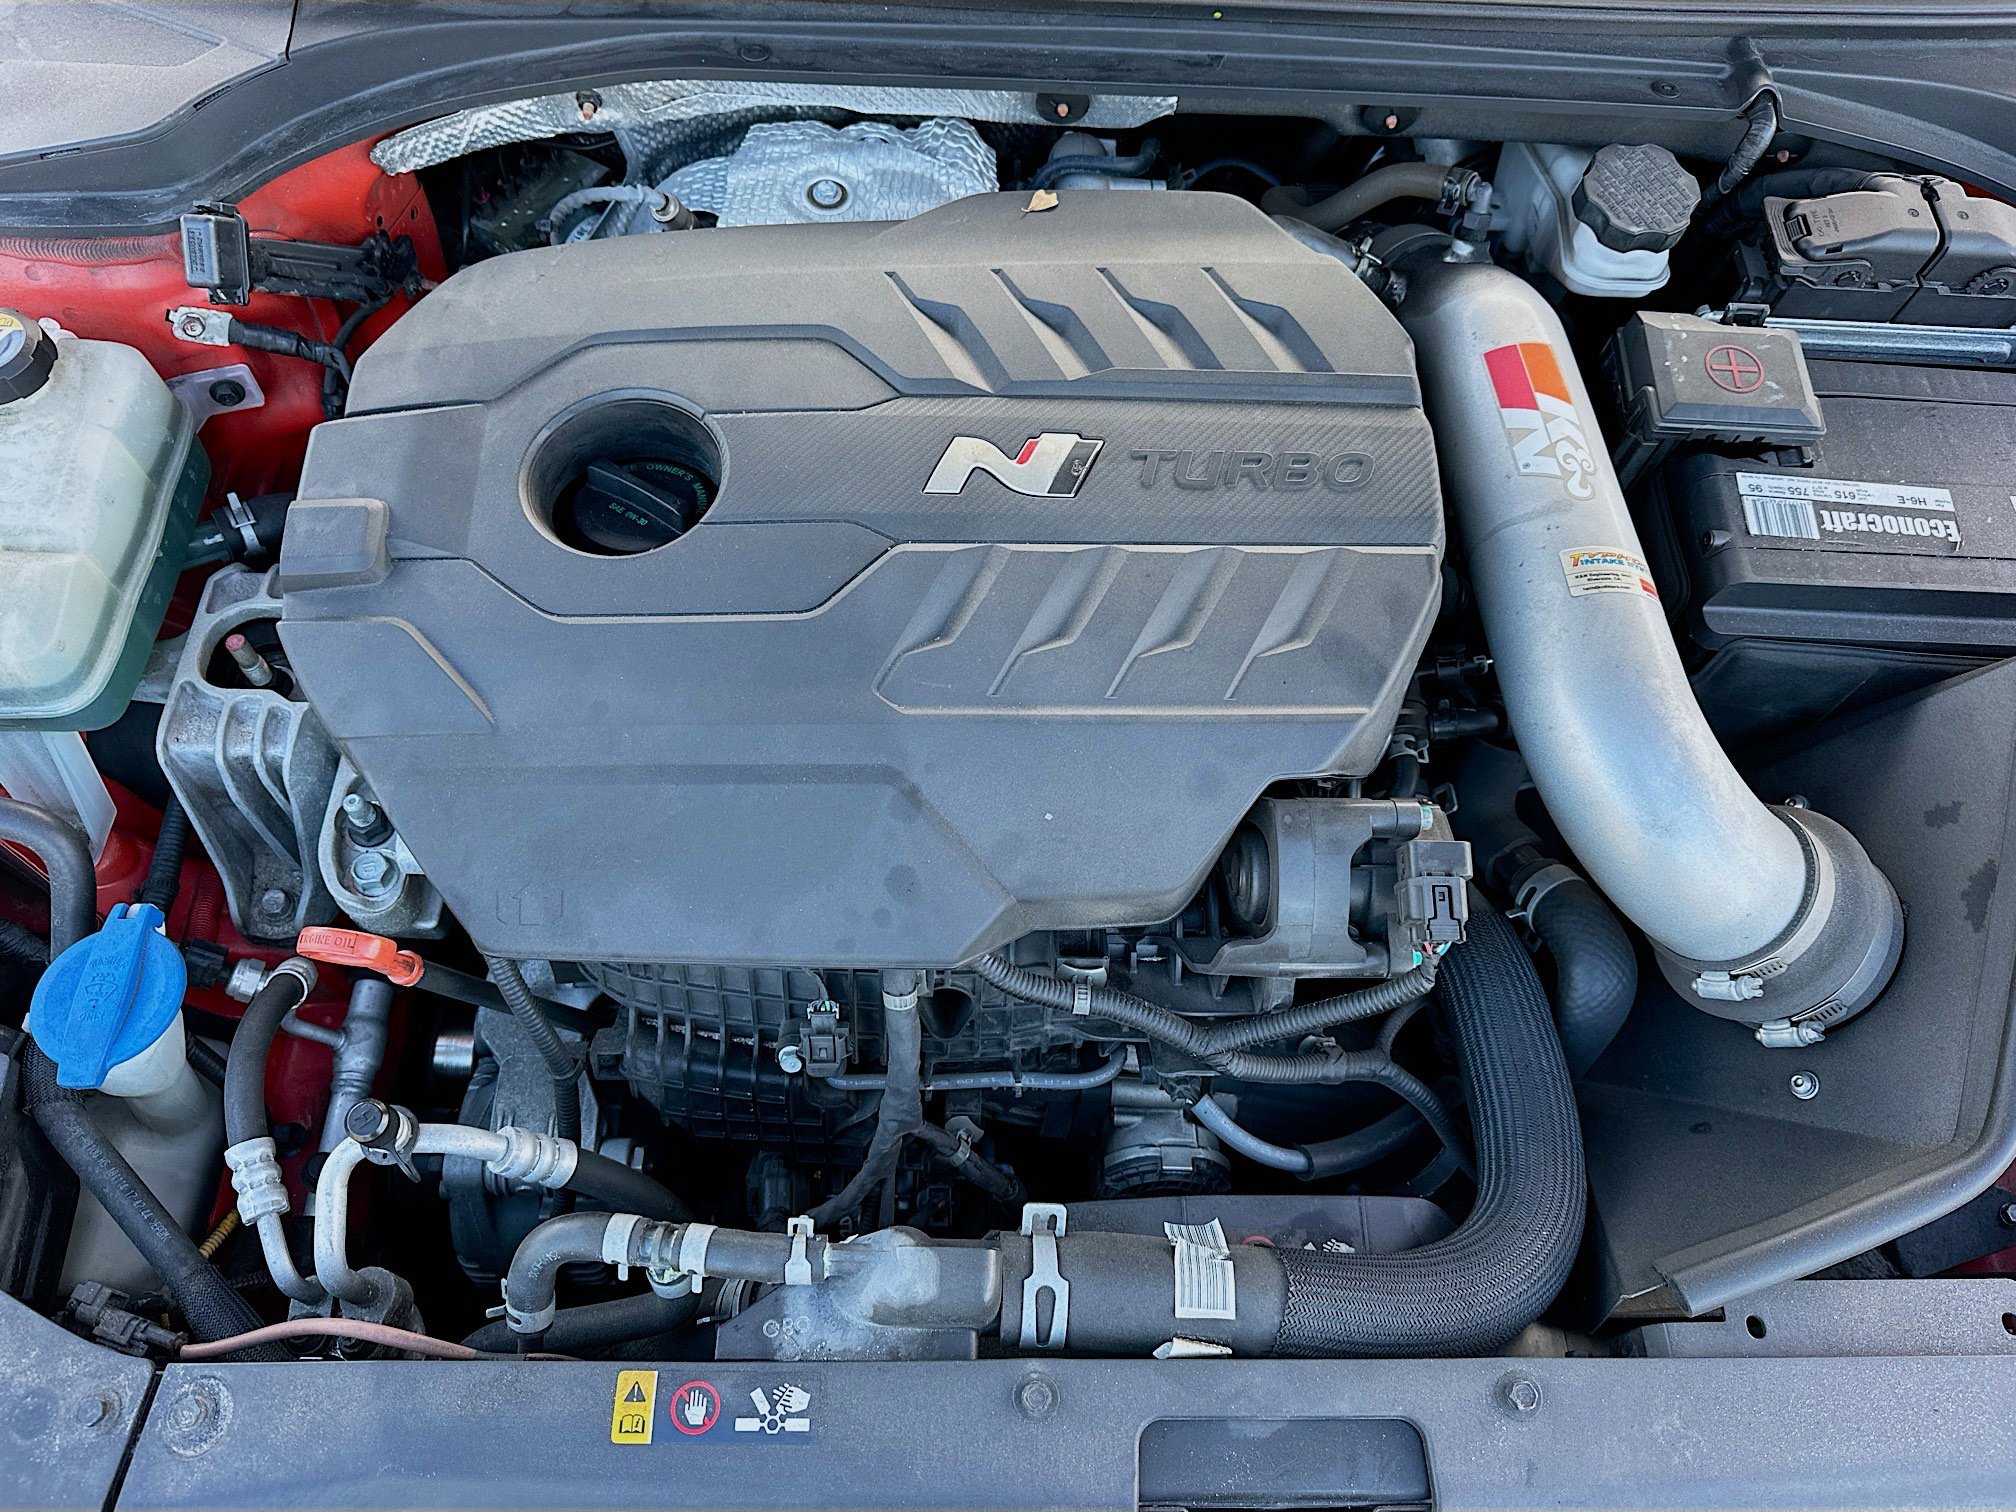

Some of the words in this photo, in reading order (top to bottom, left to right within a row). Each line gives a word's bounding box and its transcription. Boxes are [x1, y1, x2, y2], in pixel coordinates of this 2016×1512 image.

[646, 463, 694, 482] OWNER'S
[1131, 448, 1376, 493] TURBO
[1747, 483, 1764, 493] 95
[1787, 486, 1810, 497] 755
[1834, 489, 1857, 500] 615
[1896, 494, 1928, 507] H6-E
[608, 502, 625, 514] SAE
[1819, 509, 1962, 542] Econocraft
[1580, 558, 1625, 566] INTAKE
[334, 937, 356, 949] OIL
[78, 1011, 106, 1022] ONLY
